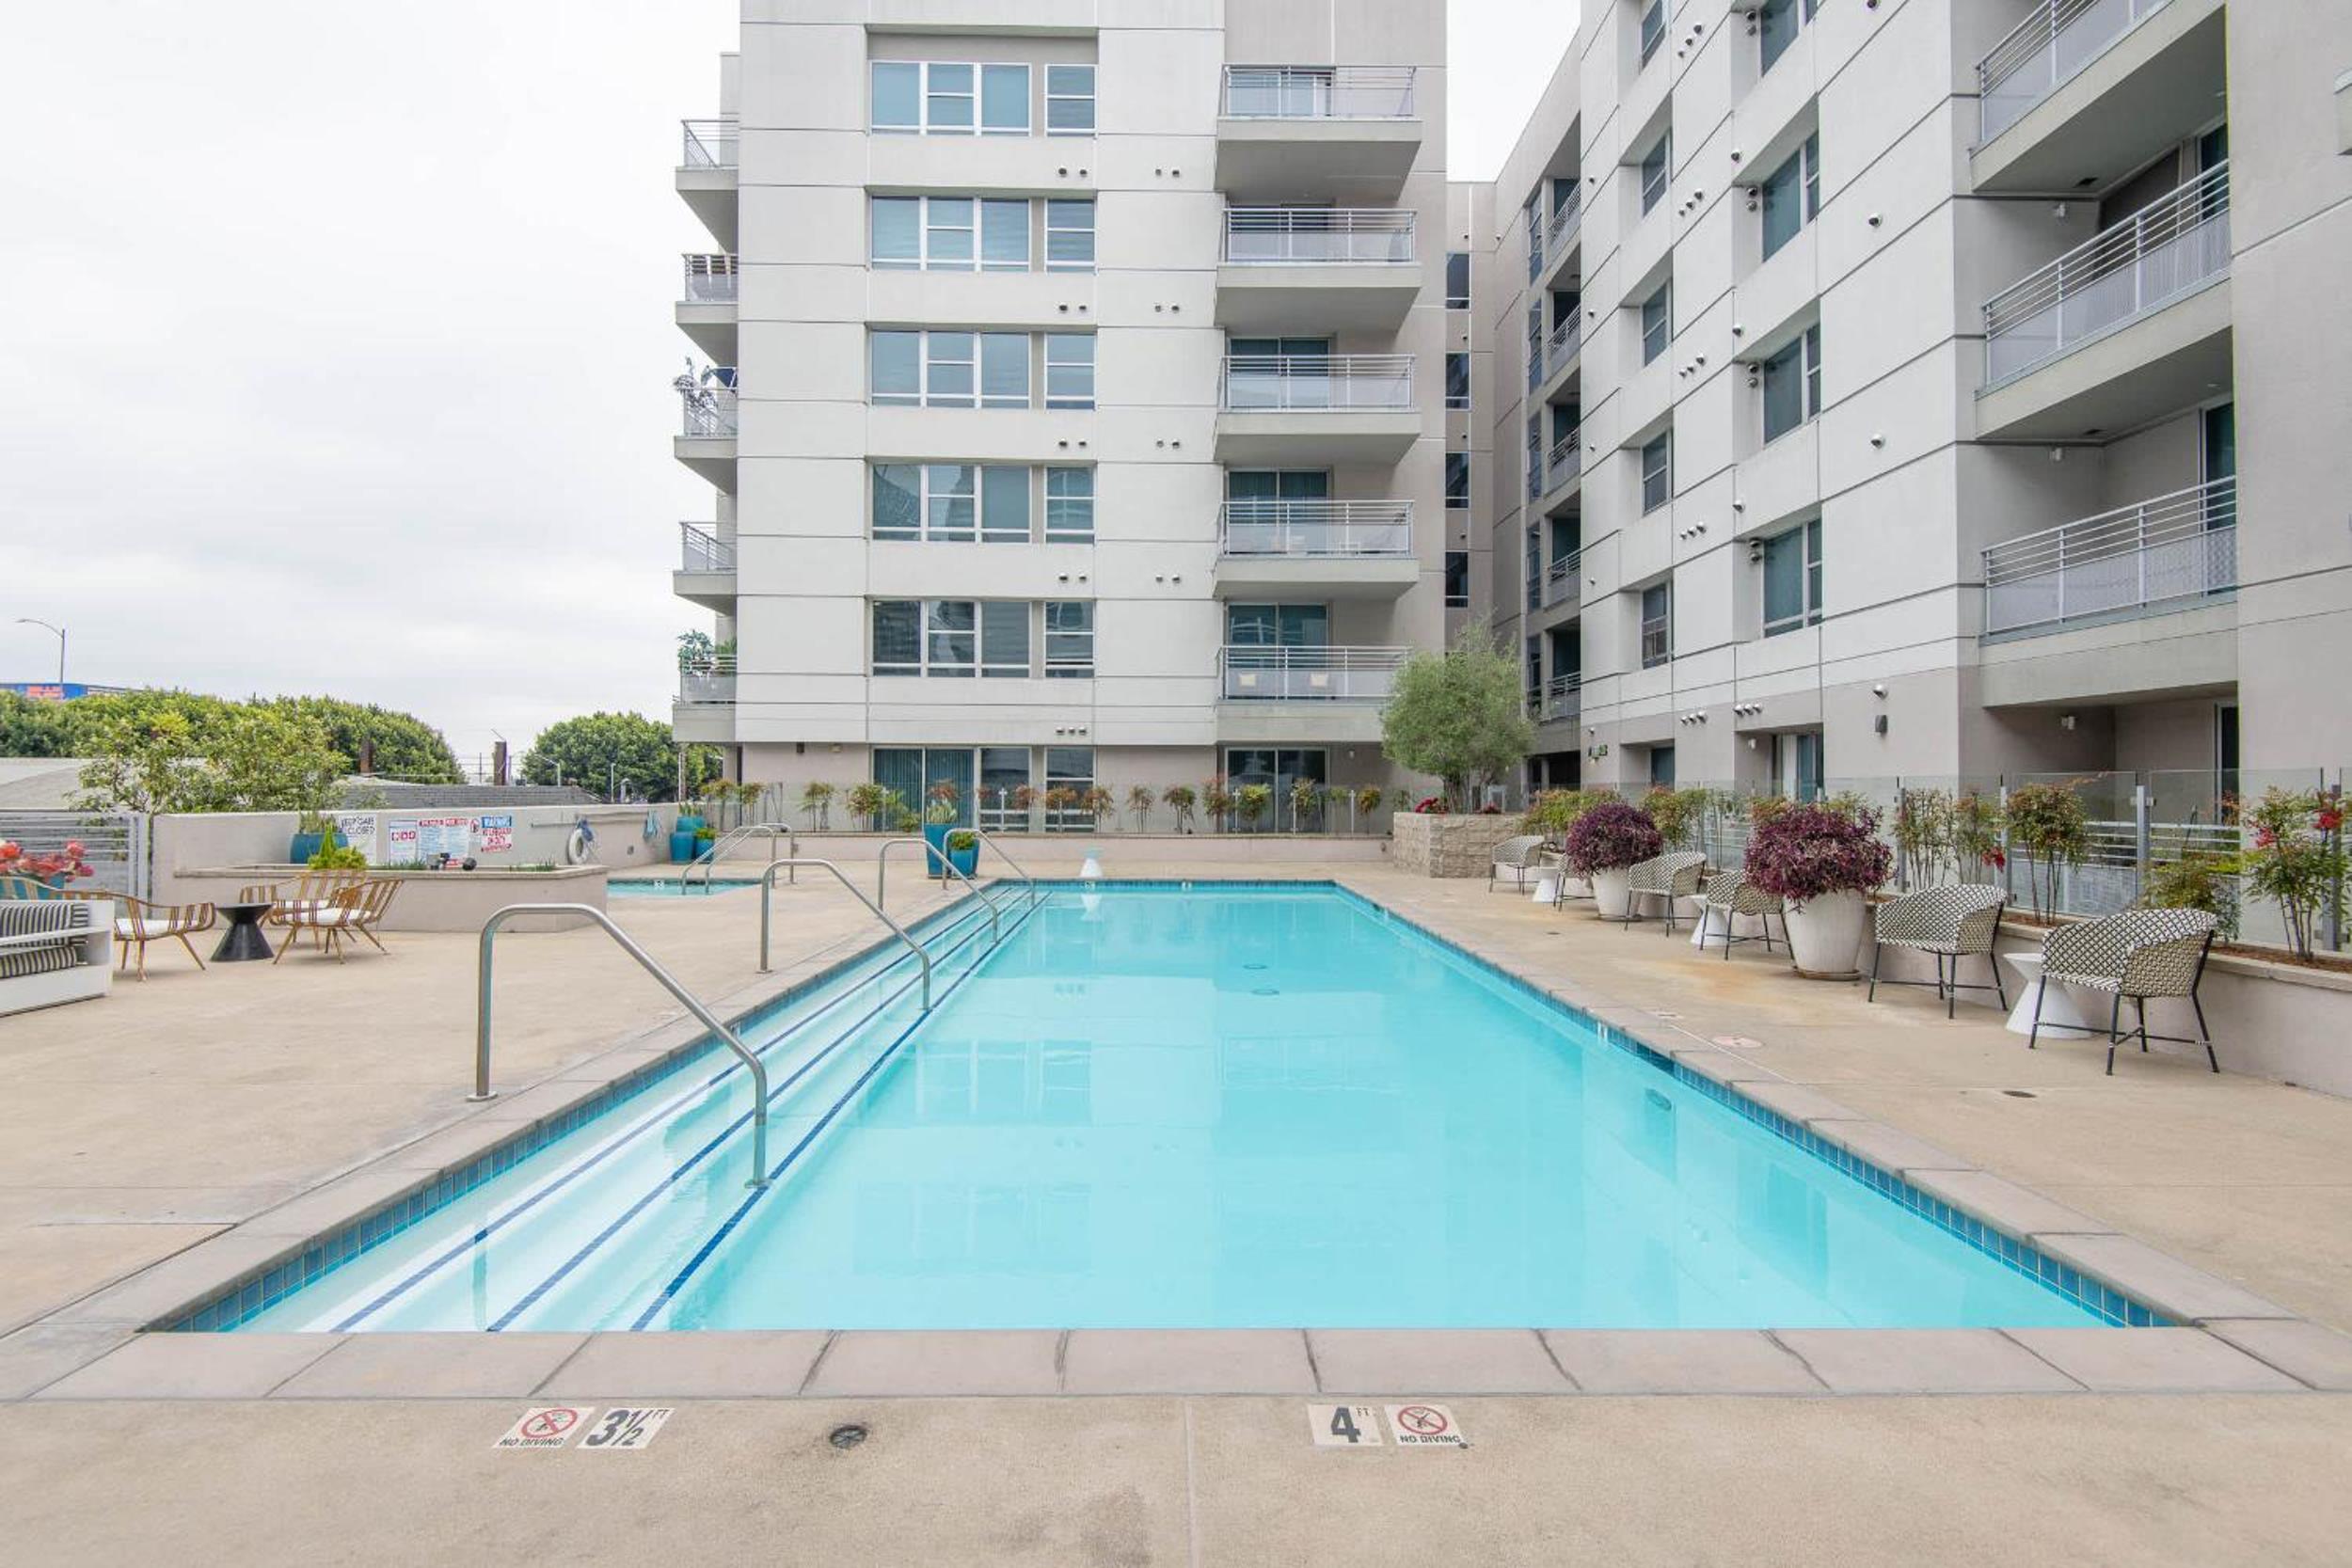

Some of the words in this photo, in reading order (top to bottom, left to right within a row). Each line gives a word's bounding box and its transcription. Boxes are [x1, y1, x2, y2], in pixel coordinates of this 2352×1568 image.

[1330, 1406, 1362, 1444] 4
[499, 1437, 518, 1447] NO
[519, 1437, 564, 1447] DIVING
[1399, 1434, 1418, 1444] NO
[1421, 1434, 1461, 1444] DIVING
